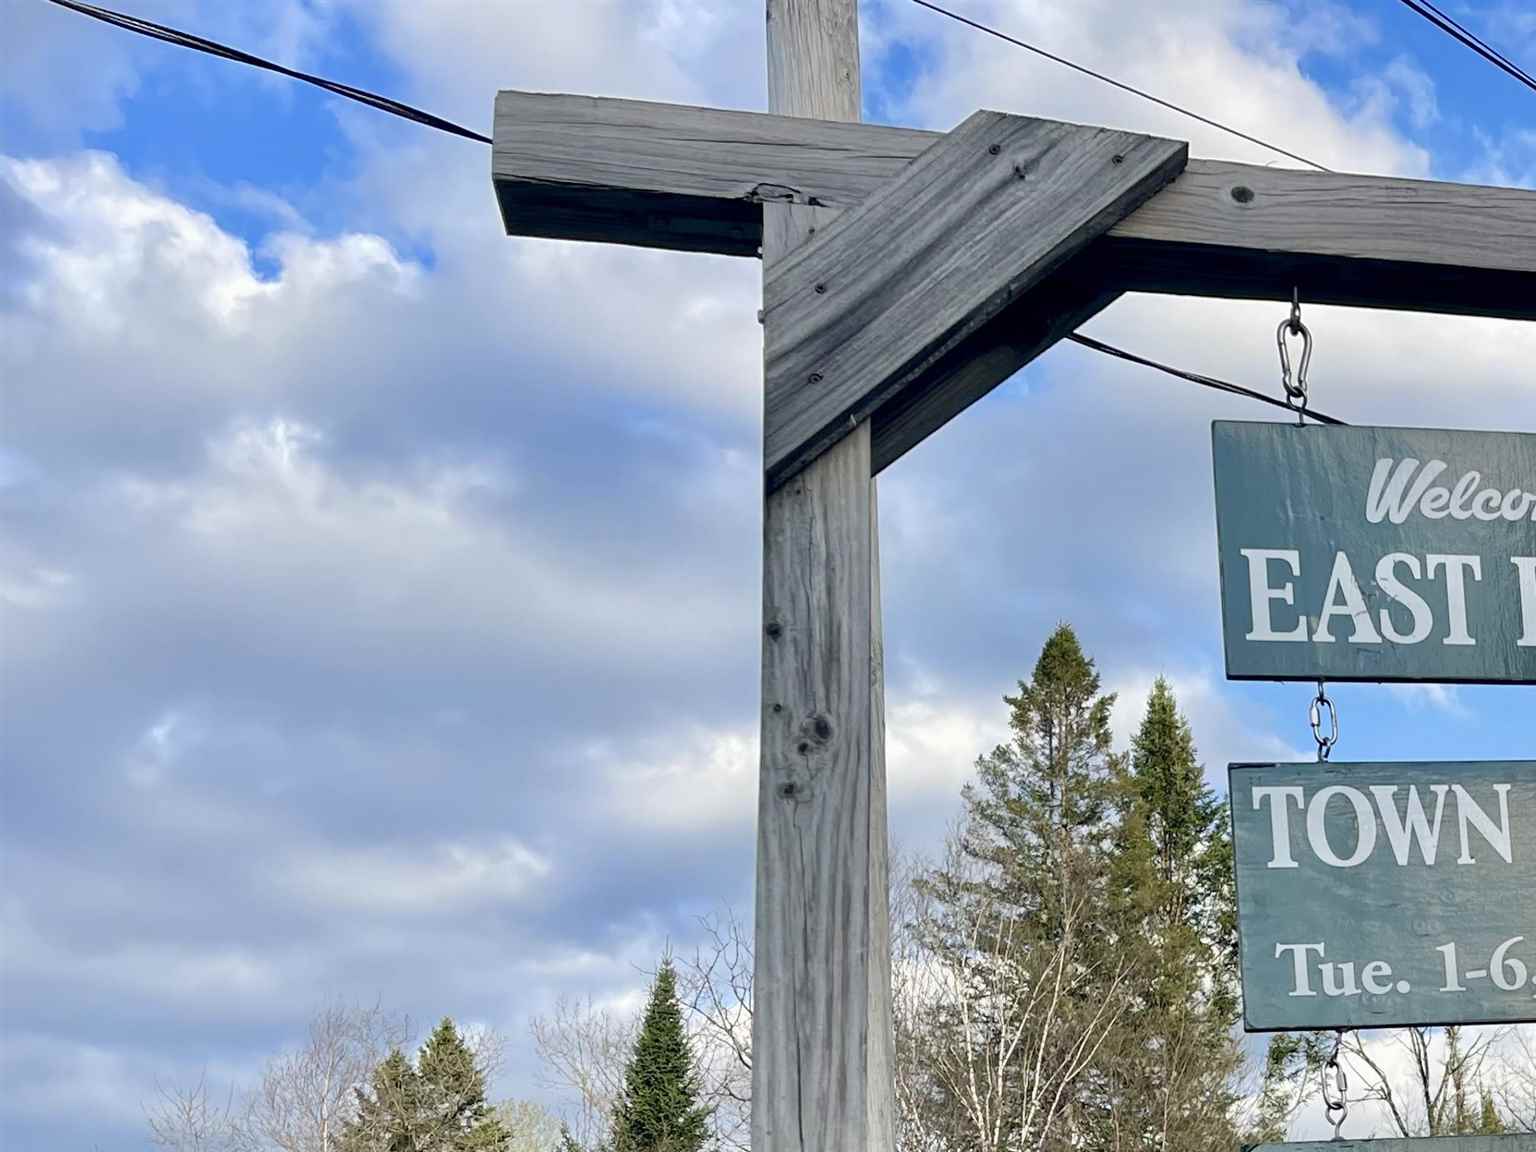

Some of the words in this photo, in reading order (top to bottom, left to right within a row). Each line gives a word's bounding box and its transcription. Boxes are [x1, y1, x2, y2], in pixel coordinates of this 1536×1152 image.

[1240, 548, 1482, 646] EAST
[1252, 783, 1513, 869] TOWN
[1274, 941, 1411, 998] Tue.
